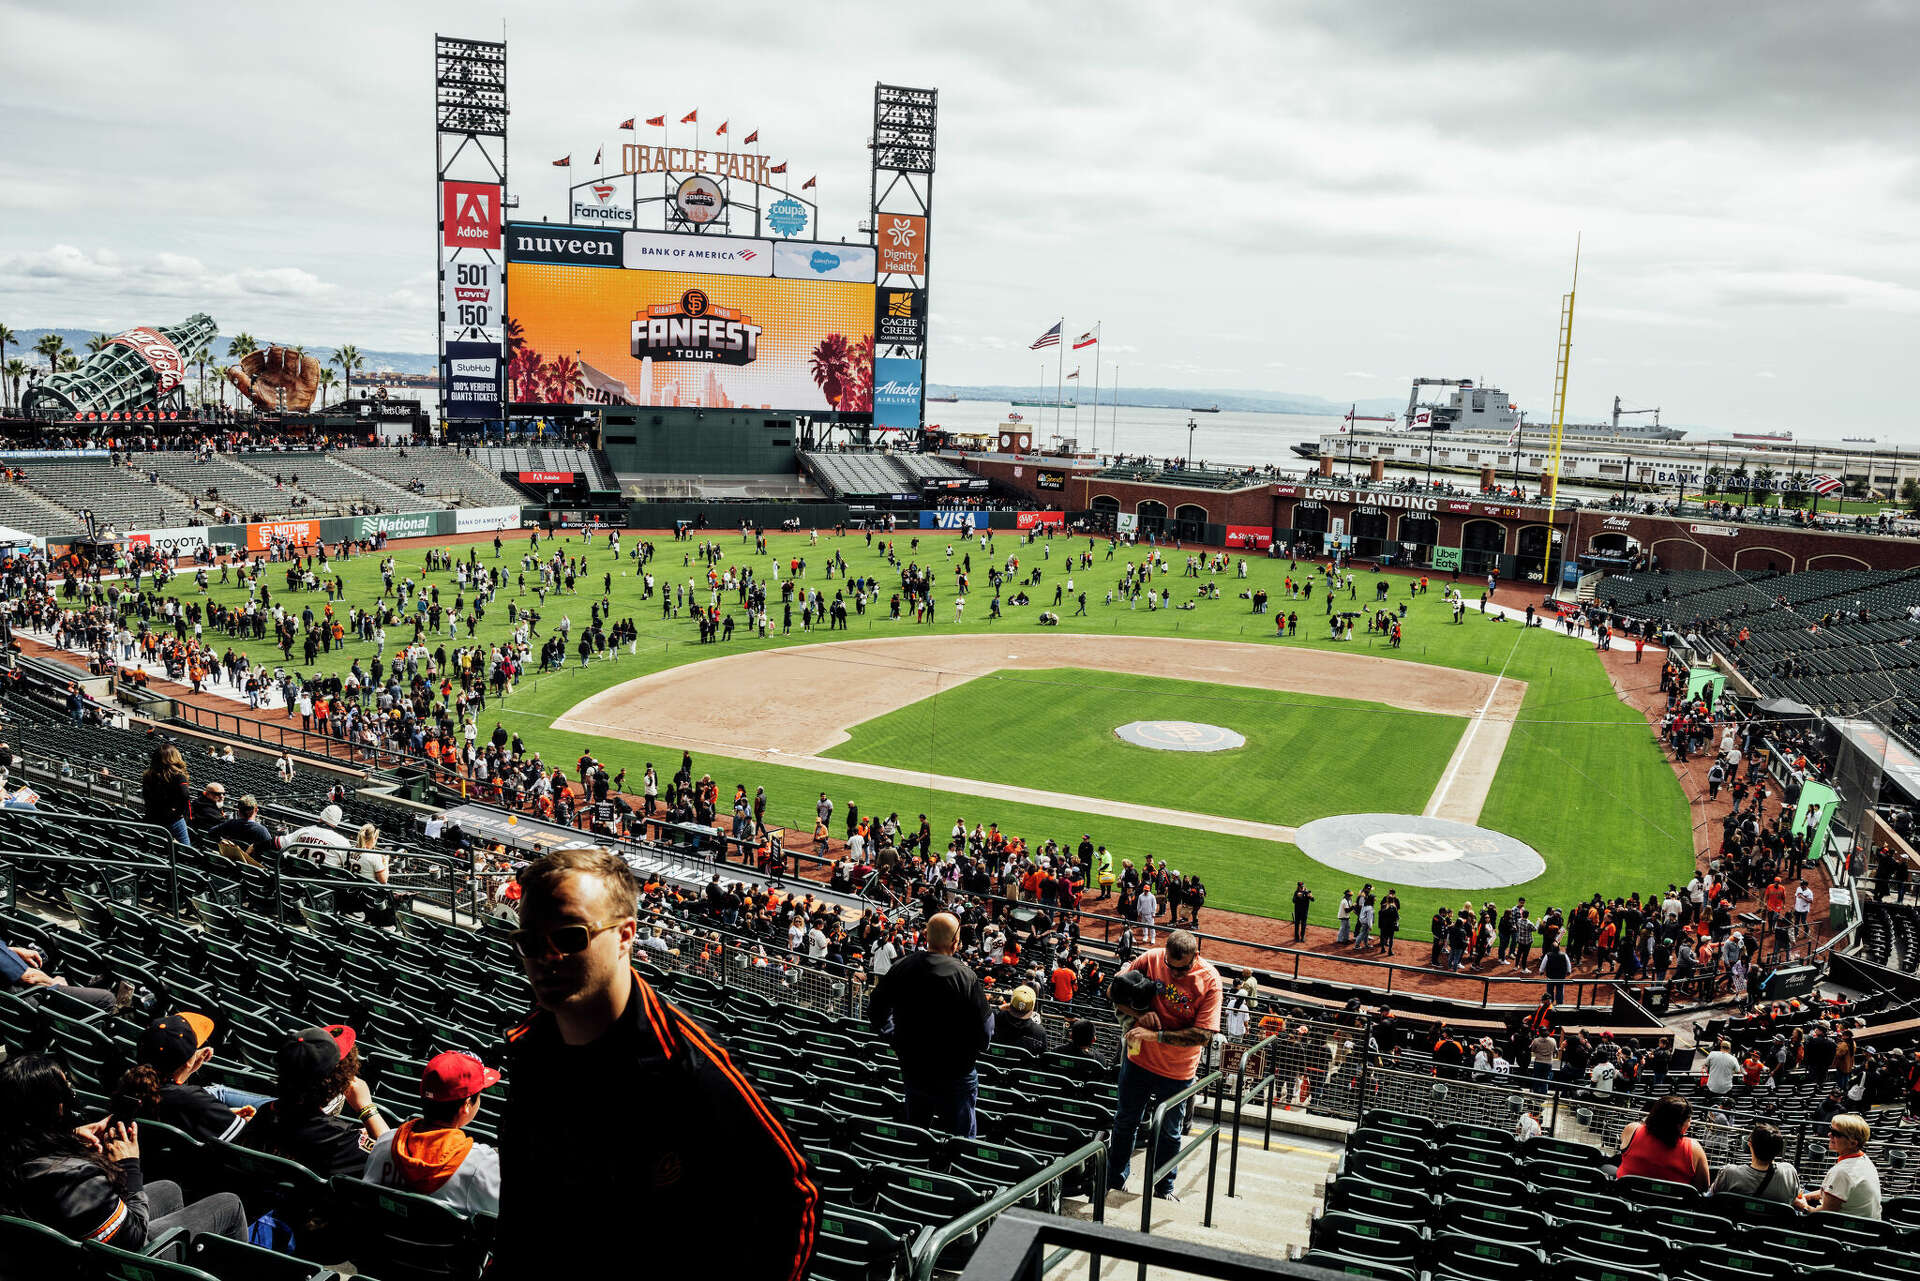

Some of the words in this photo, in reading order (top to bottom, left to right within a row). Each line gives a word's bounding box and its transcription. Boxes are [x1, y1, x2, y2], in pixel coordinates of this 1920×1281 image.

[623, 143, 707, 176] ORACLE
[715, 151, 771, 187] PARK
[574, 204, 632, 221] Fanatics
[773, 205, 805, 218] coupa
[457, 226, 489, 239] Adobe
[517, 234, 615, 257] nuveen
[641, 247, 671, 257] BANK
[673, 249, 686, 258] OF
[688, 250, 735, 261] AMERICA
[884, 249, 918, 262] Dignity
[457, 264, 488, 286] 501
[881, 317, 918, 327] CACHE
[882, 325, 916, 335] CREEK
[631, 318, 763, 360] FANFEST
[675, 349, 714, 360] TOUR
[456, 363, 491, 373] StubHub
[453, 381, 470, 392] 100%
[470, 382, 496, 392] VERIFIED
[875, 381, 921, 398] Alaska
[451, 392, 473, 402] GIANTS
[474, 392, 498, 402] TICKETS
[395, 405, 411, 416] Coffee
[1045, 473, 1064, 484] Sports
[1658, 471, 1700, 485] BANK
[1704, 474, 1723, 486] OF
[1727, 477, 1801, 492] AMERICA
[1303, 500, 1318, 509] EXIT
[1356, 492, 1438, 511] LANDING
[1362, 507, 1377, 516] EXIT
[1411, 512, 1427, 520] EXIT
[378, 516, 429, 531] National
[933, 512, 976, 529] VISA
[1602, 516, 1631, 527] Alaska
[274, 522, 310, 536] NOTHING
[411, 529, 427, 538] Rental
[156, 536, 204, 549] TOYOTA
[1436, 549, 1459, 559] Uber
[1435, 559, 1459, 569] Eats
[1527, 572, 1544, 580] 309
[1602, 1069, 1614, 1081] 23
